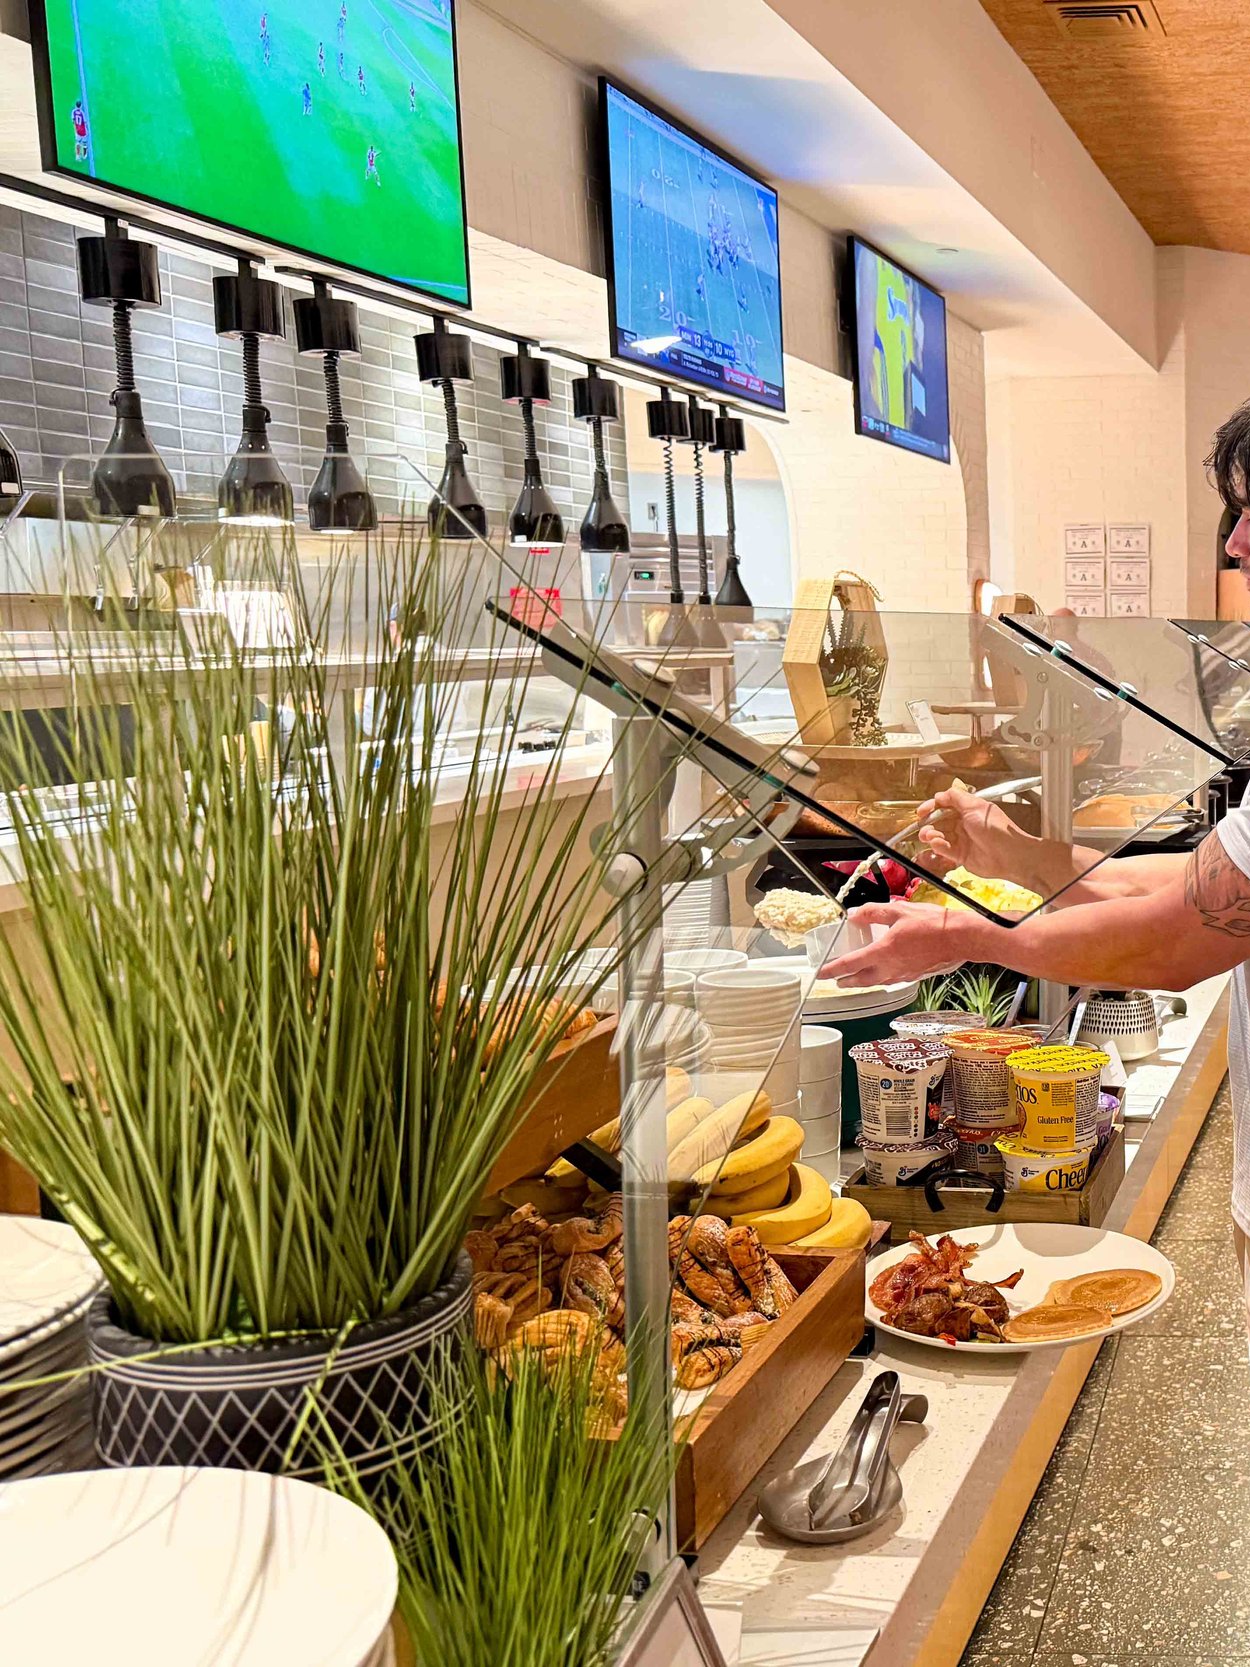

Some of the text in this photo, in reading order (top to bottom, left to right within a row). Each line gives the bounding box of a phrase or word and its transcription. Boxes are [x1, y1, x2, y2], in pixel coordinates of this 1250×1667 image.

[694, 334, 702, 348] 13
[715, 343, 723, 356] 10
[1037, 1115, 1073, 1124] Gluten Free
